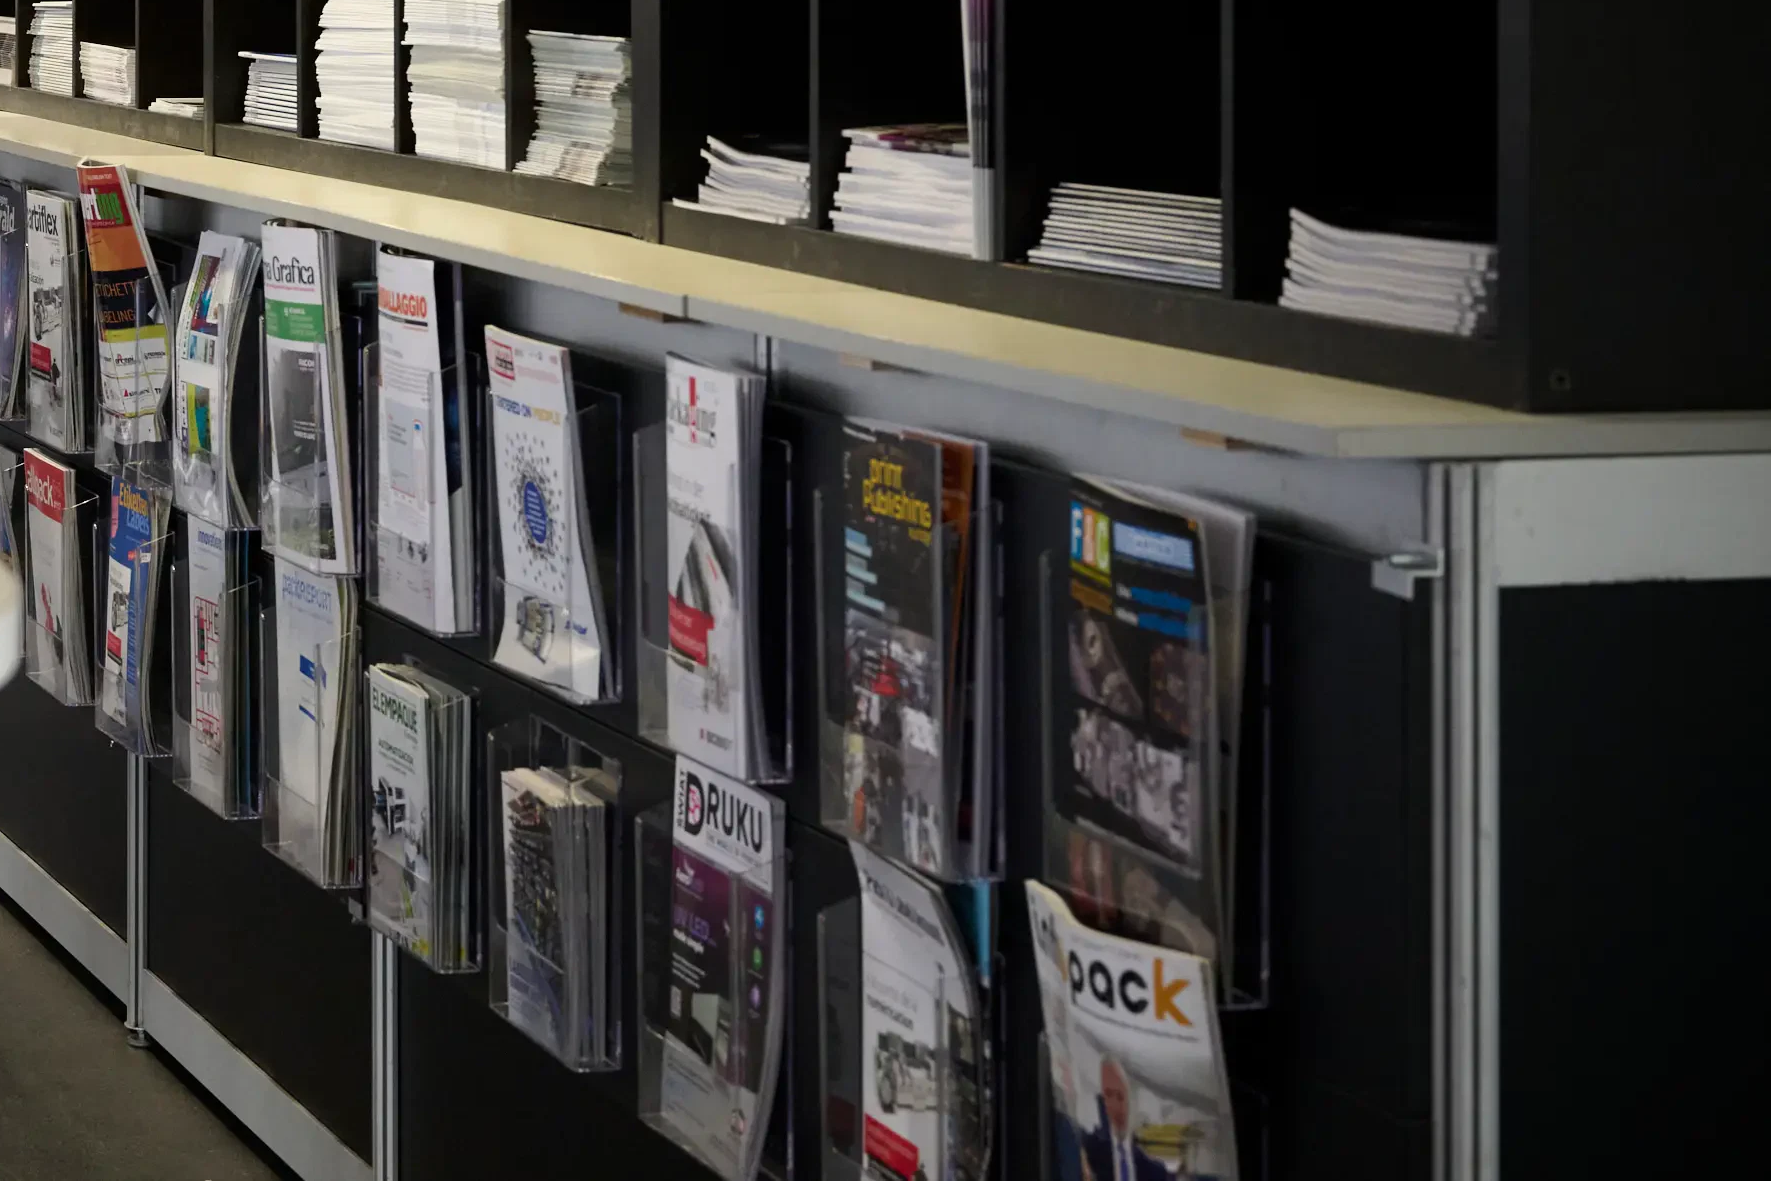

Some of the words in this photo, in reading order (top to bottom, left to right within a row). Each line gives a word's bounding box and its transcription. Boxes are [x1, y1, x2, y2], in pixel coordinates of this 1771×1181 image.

[271, 255, 316, 285] Grafica
[684, 770, 763, 854] DRUKU
[1068, 949, 1195, 1028] pack
